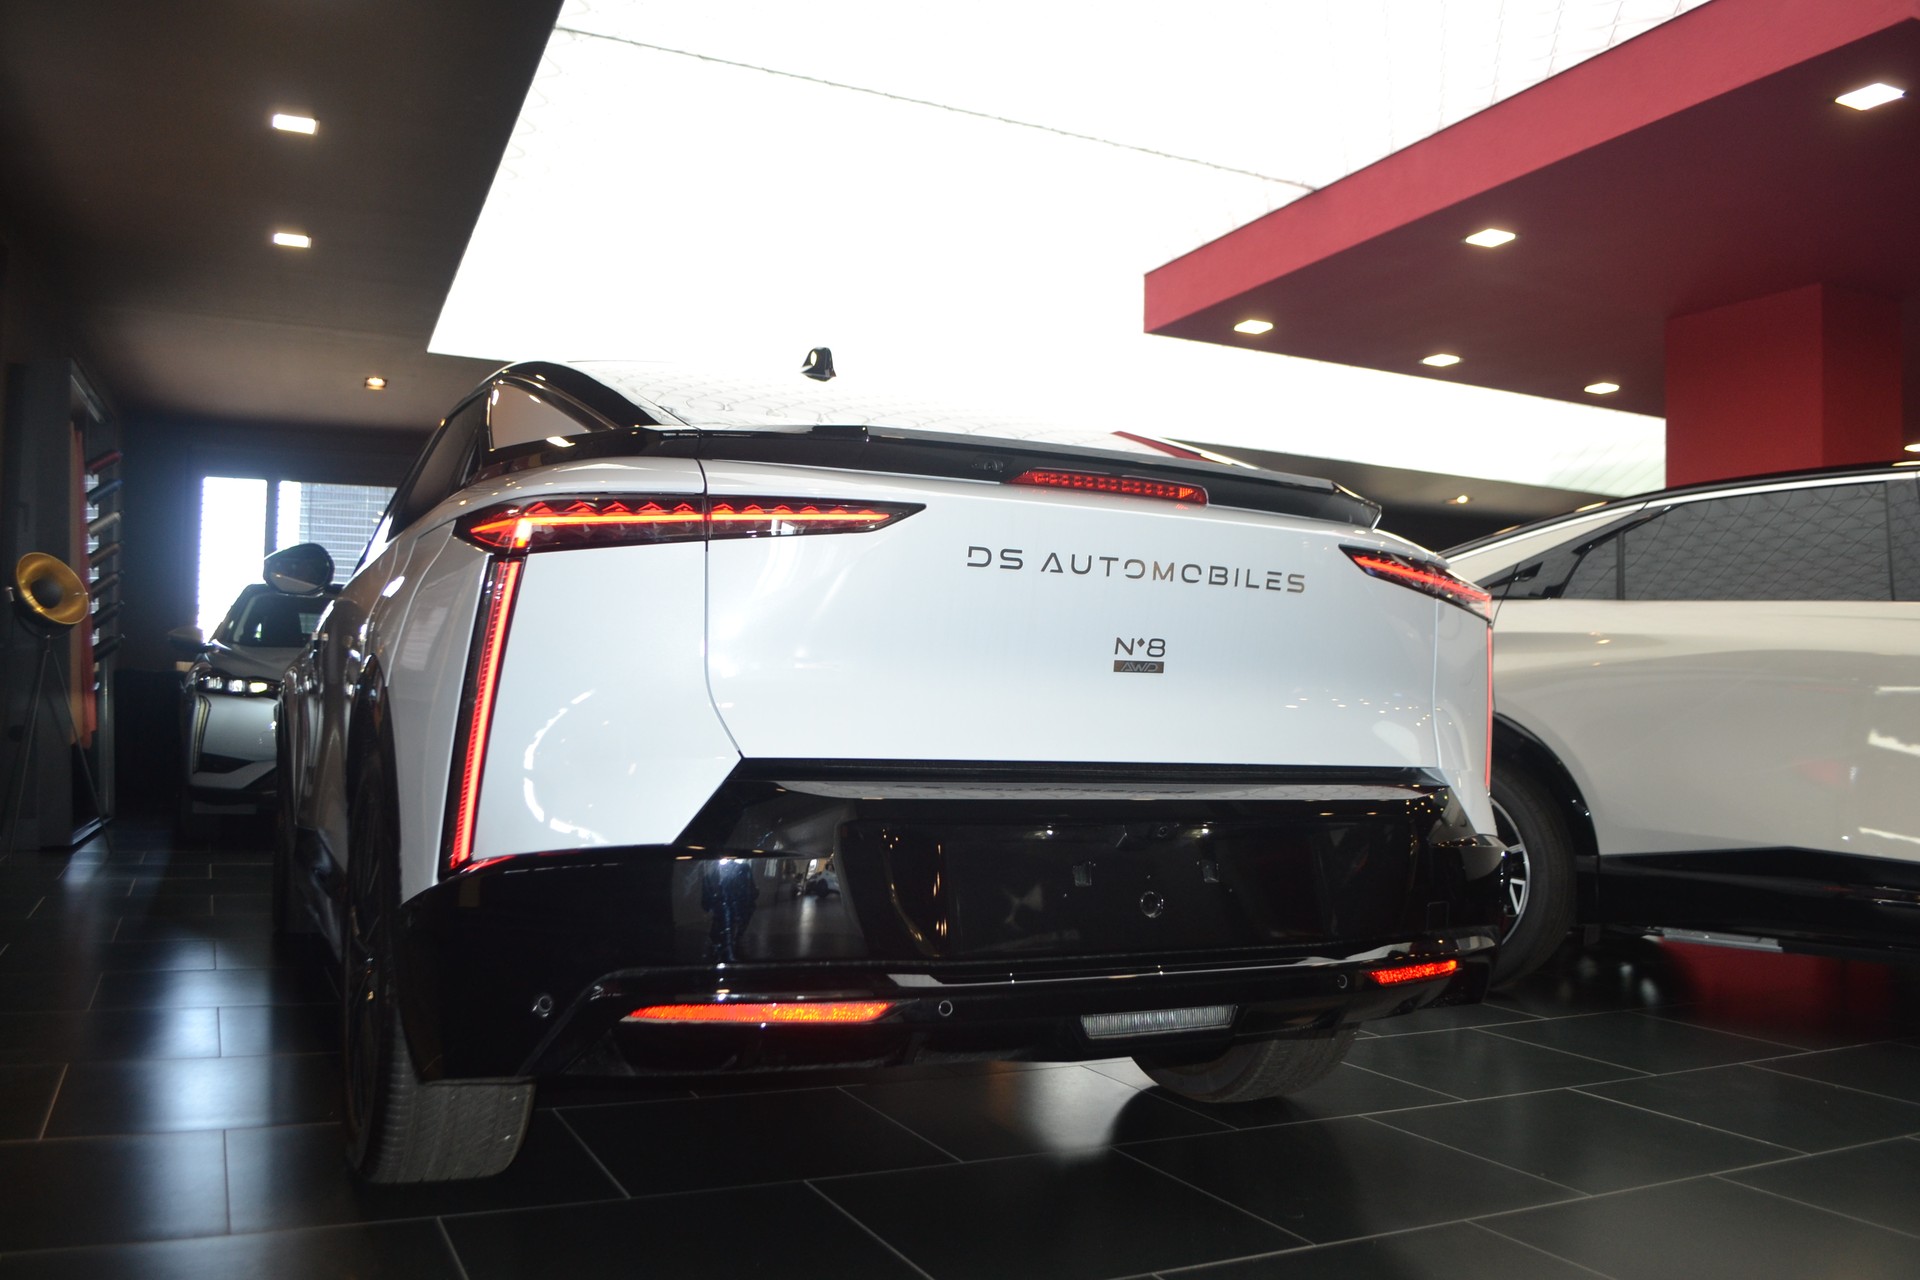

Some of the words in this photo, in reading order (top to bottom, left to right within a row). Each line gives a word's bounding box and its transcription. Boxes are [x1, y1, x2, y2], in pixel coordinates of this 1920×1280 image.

[967, 546, 1024, 570] DS
[1040, 552, 1305, 593] AUTOMOBILES
[1120, 661, 1159, 672] AWD
